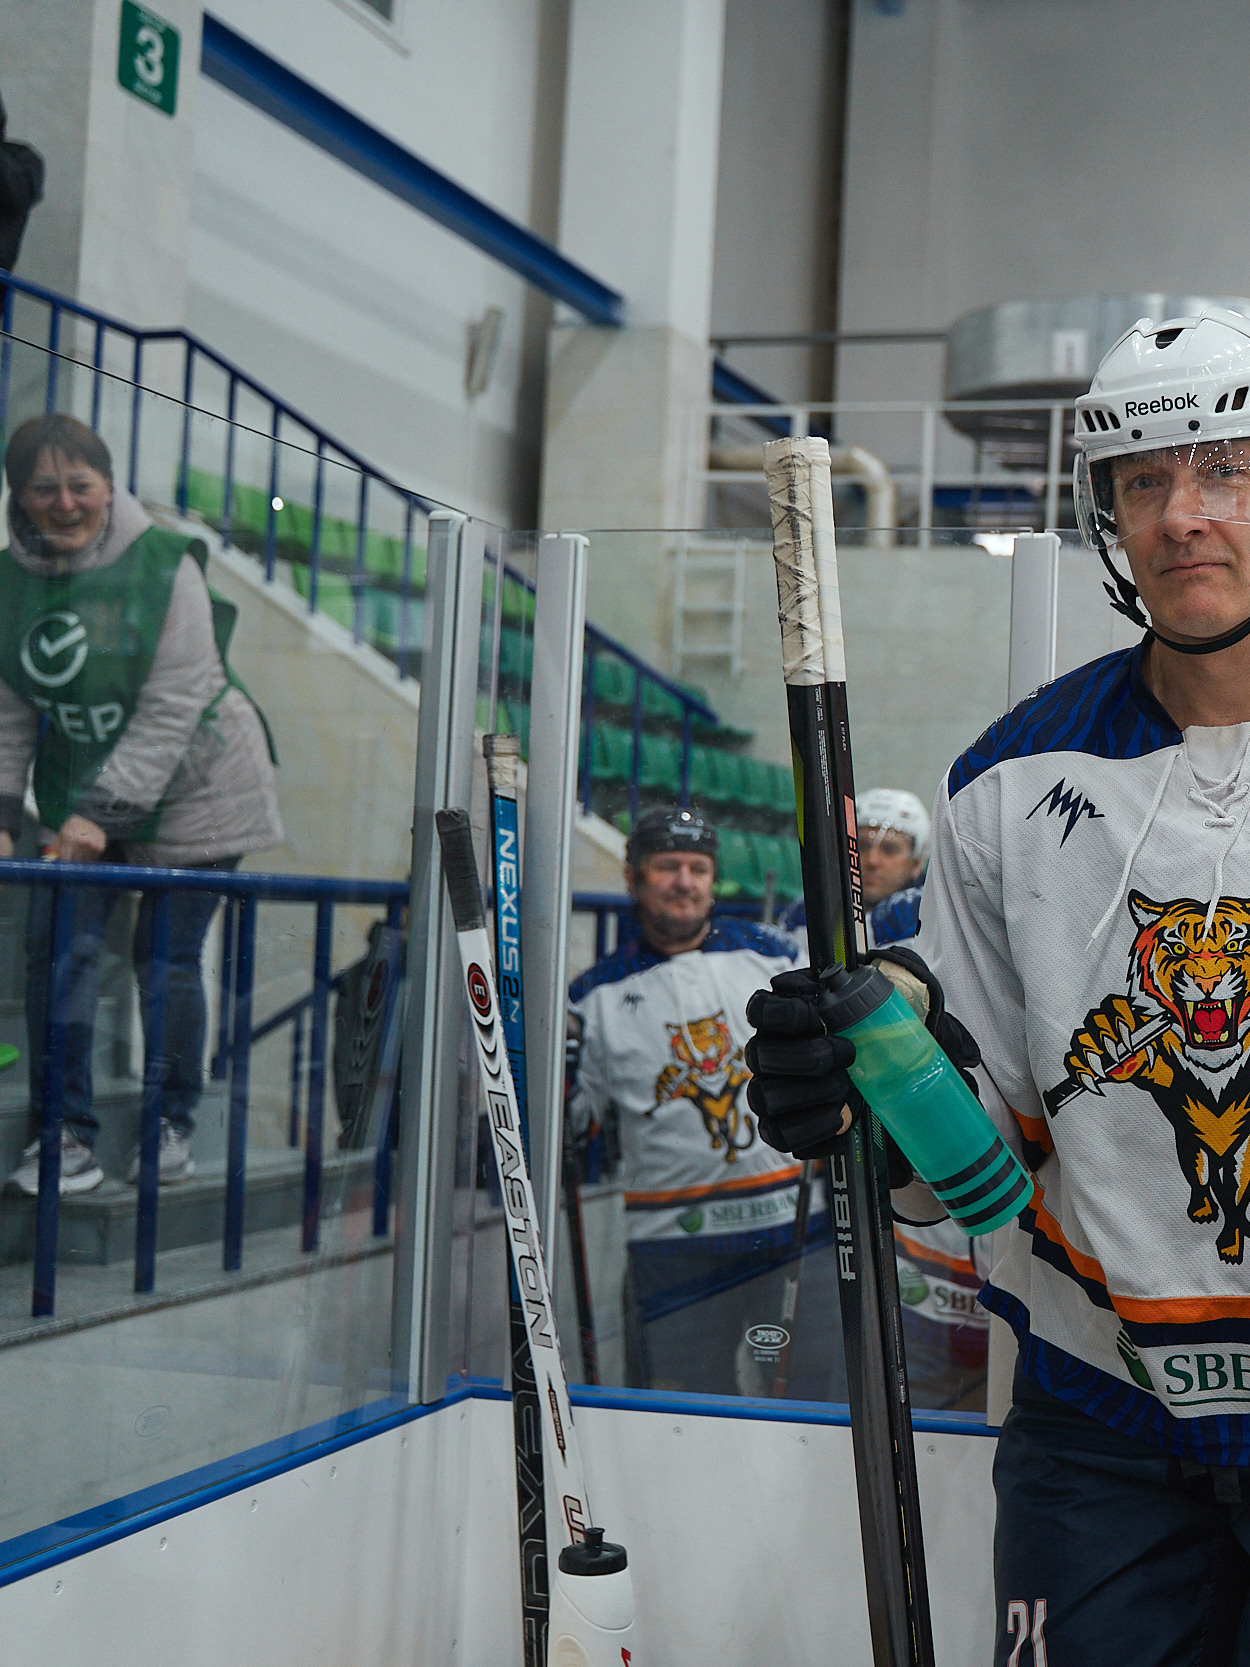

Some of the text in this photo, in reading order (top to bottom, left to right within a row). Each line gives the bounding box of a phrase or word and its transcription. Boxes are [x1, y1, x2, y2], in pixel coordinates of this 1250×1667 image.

[134, 26, 165, 87] 3
[1124, 392, 1200, 419] Reebok
[499, 827, 520, 973] NEXUS
[487, 1089, 554, 1350] EASTON
[829, 1154, 857, 1282] RIBC
